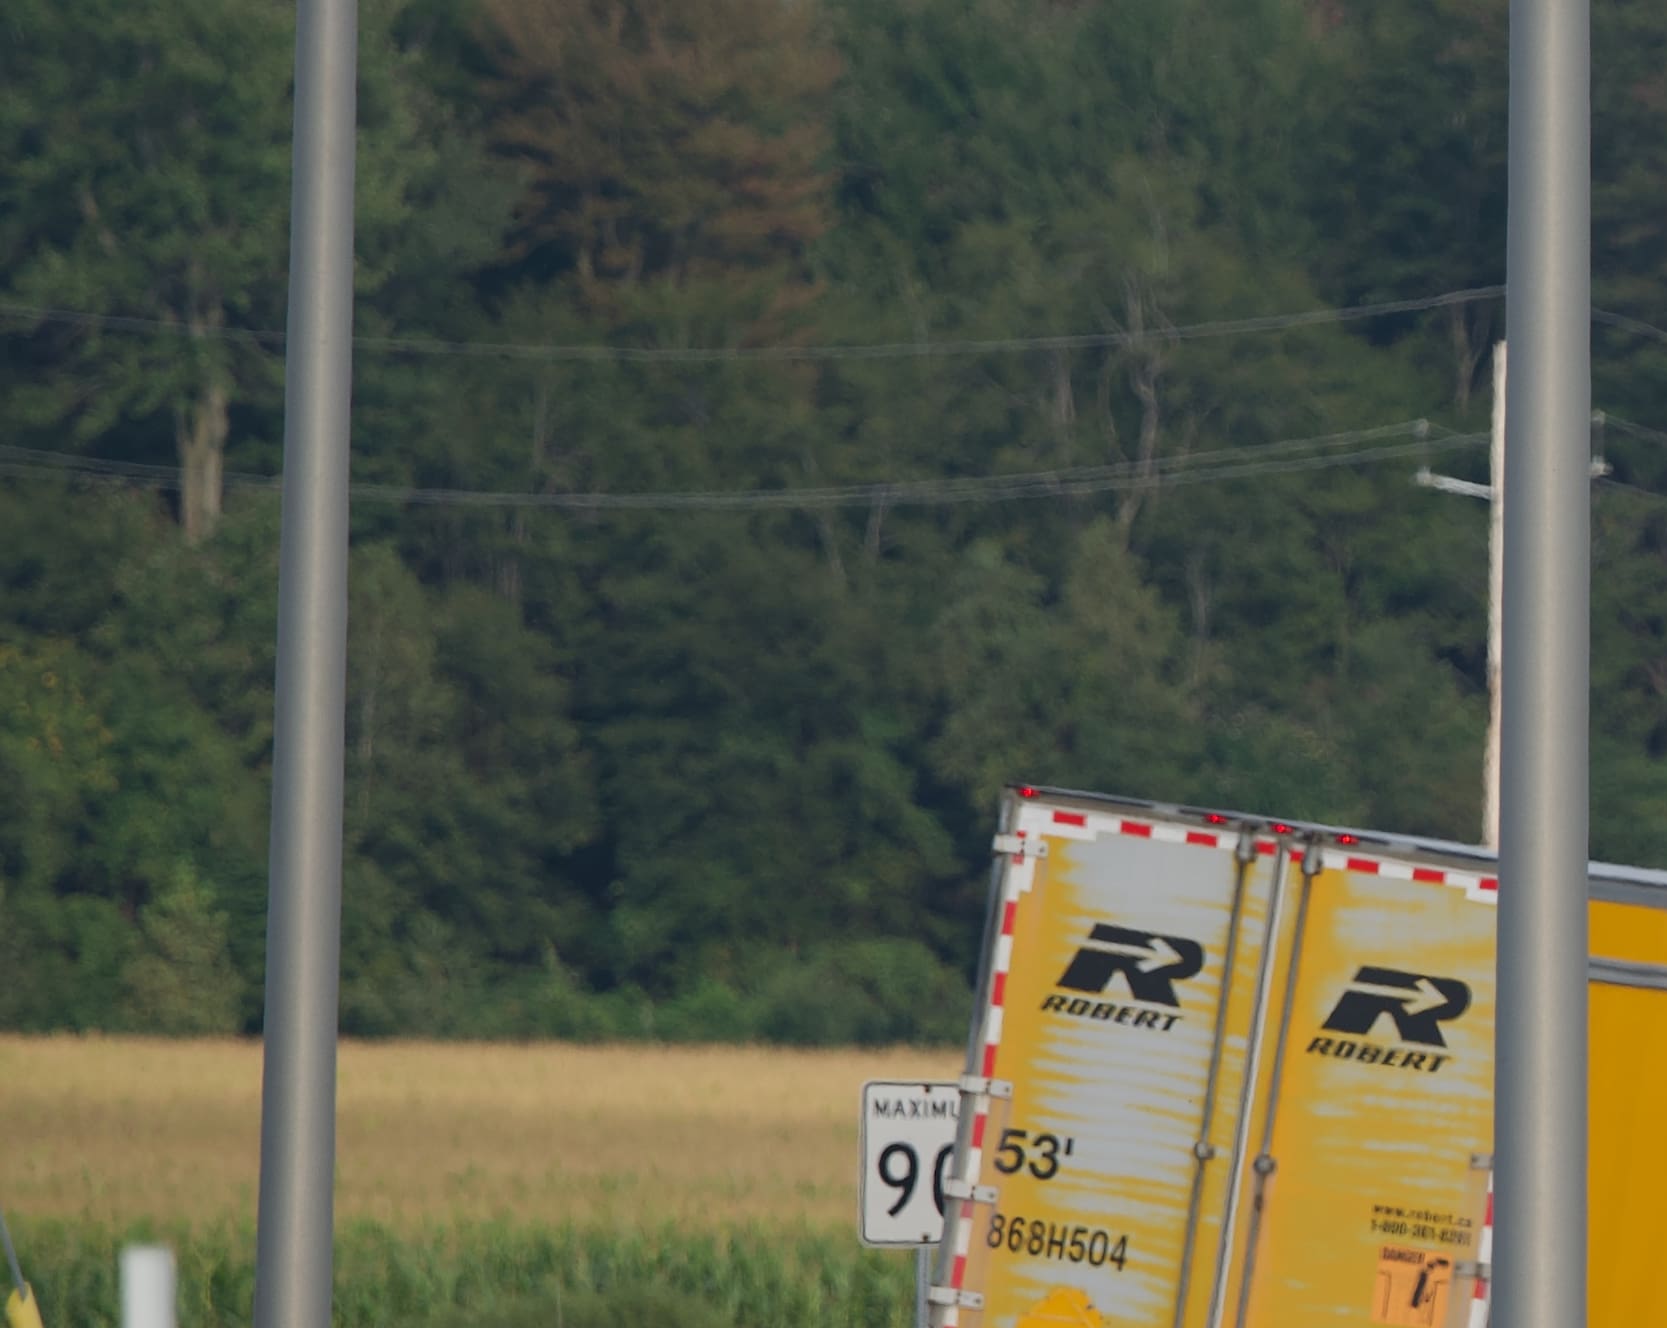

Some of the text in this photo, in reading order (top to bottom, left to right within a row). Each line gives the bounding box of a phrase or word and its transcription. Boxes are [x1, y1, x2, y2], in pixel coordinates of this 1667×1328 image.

[1040, 994, 1184, 1031] ROBERT
[1306, 1036, 1451, 1072] ROBERT
[993, 1127, 1075, 1181] 53'
[986, 1213, 1129, 1273] 868H504
